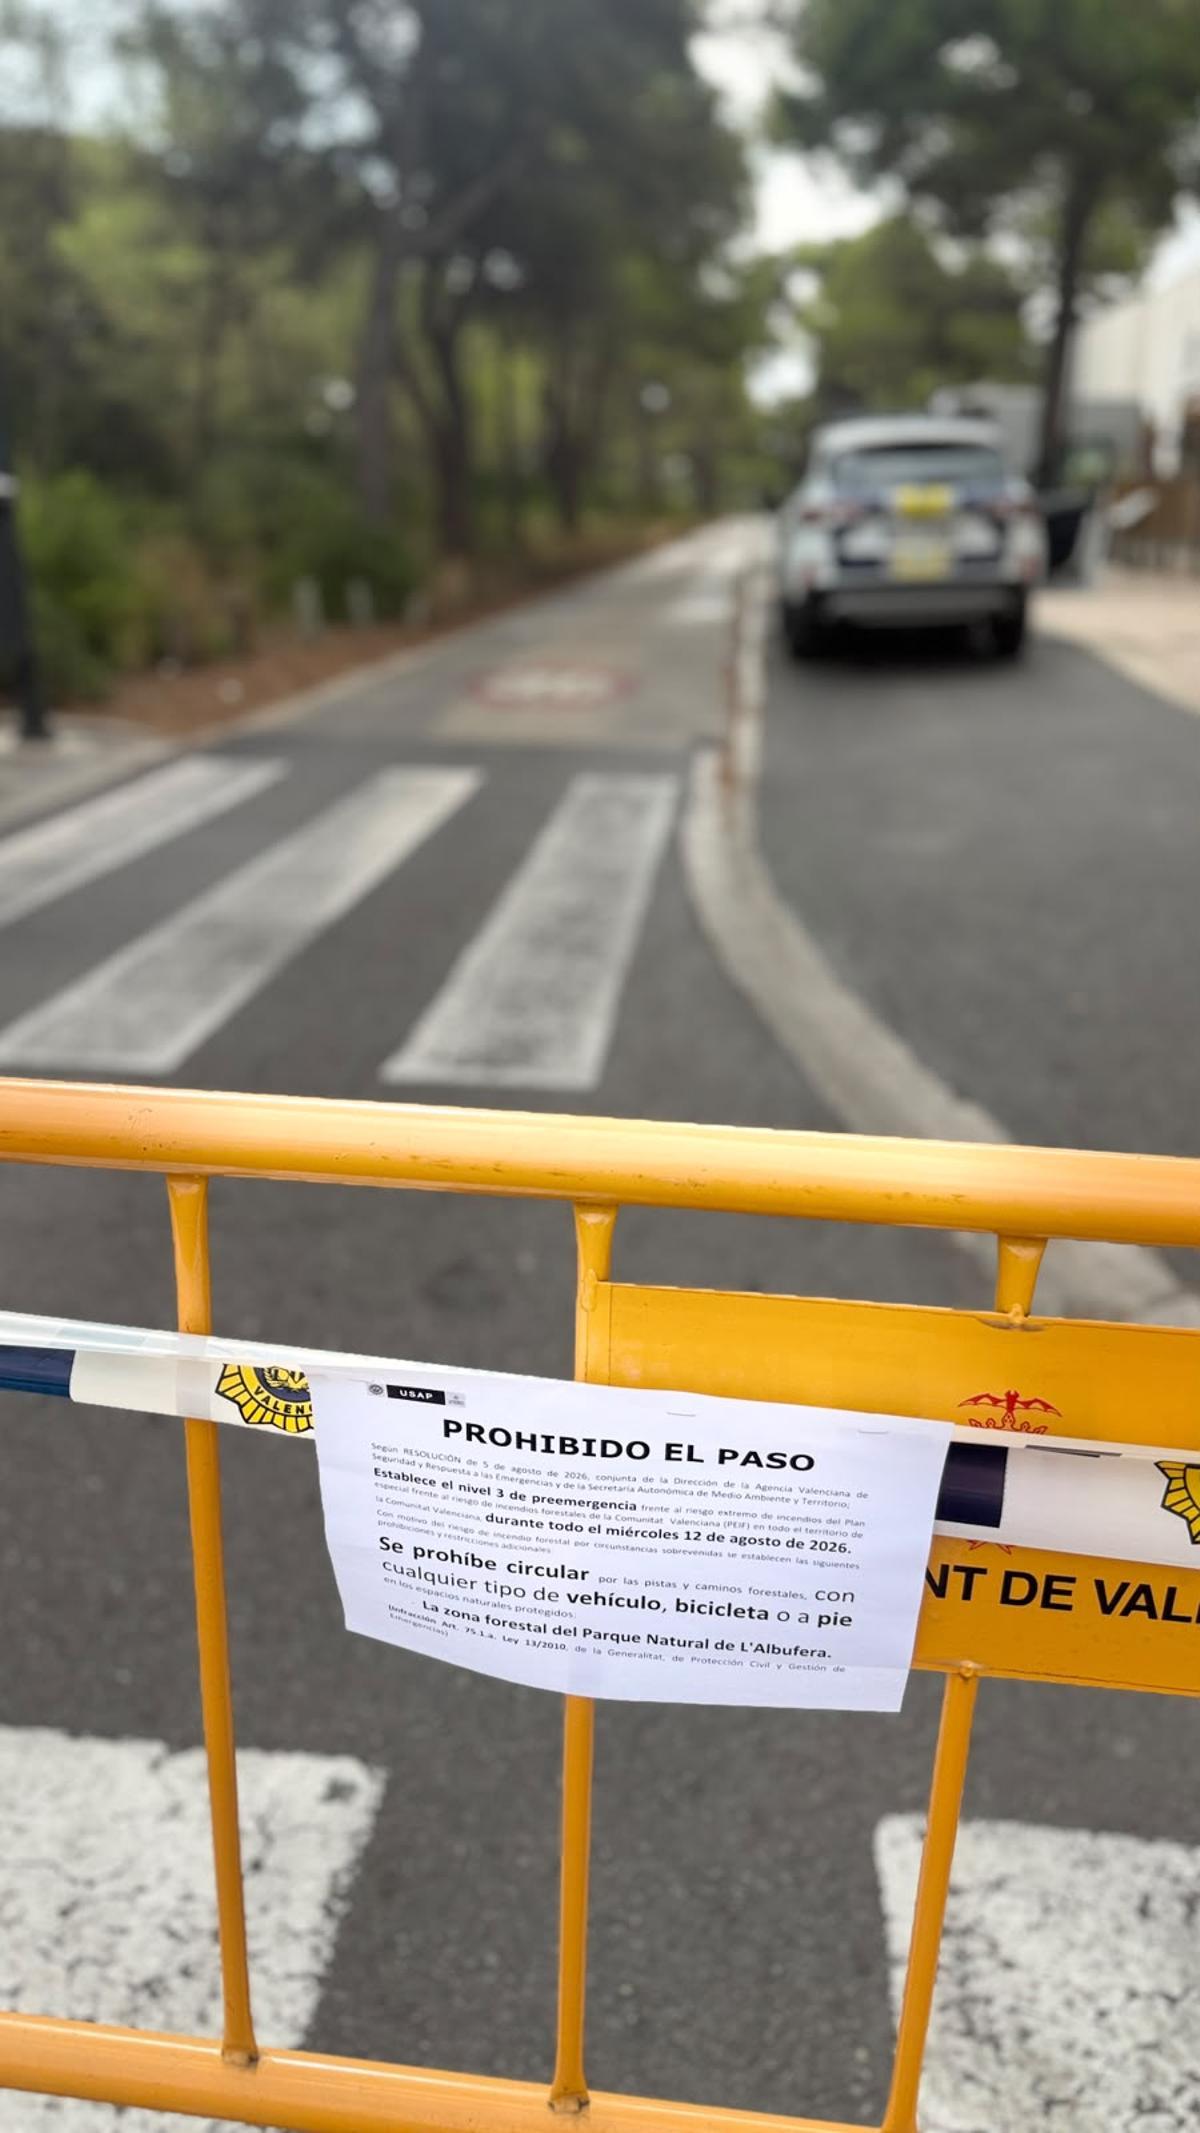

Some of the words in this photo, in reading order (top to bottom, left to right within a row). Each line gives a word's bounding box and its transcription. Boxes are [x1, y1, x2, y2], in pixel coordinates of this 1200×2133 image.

[443, 1419, 651, 1460] PROHIBIDO
[665, 1443, 705, 1463] EL
[718, 1448, 815, 1471] PASO
[373, 1467, 437, 1487] Establece
[442, 1480, 454, 1490] el
[458, 1483, 491, 1496] nivel
[496, 1488, 504, 1498] 3
[509, 1490, 526, 1502] de
[532, 1495, 637, 1511] preemergencia
[641, 1504, 670, 1513] frente
[673, 1506, 682, 1514] al
[686, 1507, 714, 1516] riesgo
[718, 1509, 757, 1519] extremo
[761, 1512, 773, 1520] de
[776, 1514, 822, 1524] incendios
[826, 1518, 841, 1526] del
[845, 1519, 865, 1527] Plan
[385, 1497, 430, 1512] Comunitat
[485, 1513, 544, 1529] durante
[548, 1520, 584, 1533] todo
[588, 1525, 601, 1535] el
[605, 1526, 680, 1540] miércoles
[684, 1531, 701, 1541] 12
[706, 1532, 726, 1543] de
[729, 1535, 781, 1547] agosto
[785, 1538, 806, 1549] de
[809, 1539, 852, 1554] 2026.
[379, 1536, 404, 1554] Se
[413, 1545, 497, 1571] prohíbe
[507, 1560, 590, 1581] circular
[598, 1576, 617, 1584] por
[623, 1577, 639, 1586] las
[644, 1579, 677, 1589] pistas
[683, 1582, 690, 1590] y
[695, 1583, 743, 1594] caminos
[815, 1590, 855, 1603] con
[382, 1561, 477, 1590] cualquier
[485, 1580, 526, 1599] tipo
[533, 1587, 560, 1602] de
[566, 1591, 667, 1614] vehículo,
[675, 1598, 769, 1621] bicicleta
[777, 1610, 790, 1622] o
[798, 1612, 809, 1623] a
[818, 1612, 853, 1628] pie
[999, 1570, 1077, 1612] DE
[1094, 1579, 1200, 1625] VAL
[422, 1600, 439, 1613] La
[444, 1606, 481, 1623] zona
[485, 1614, 547, 1634] forestal
[552, 1625, 577, 1637] del
[582, 1628, 641, 1644] Parque
[646, 1634, 709, 1650] Natural
[714, 1640, 735, 1652] de
[740, 1641, 832, 1659] L'Albufera.
